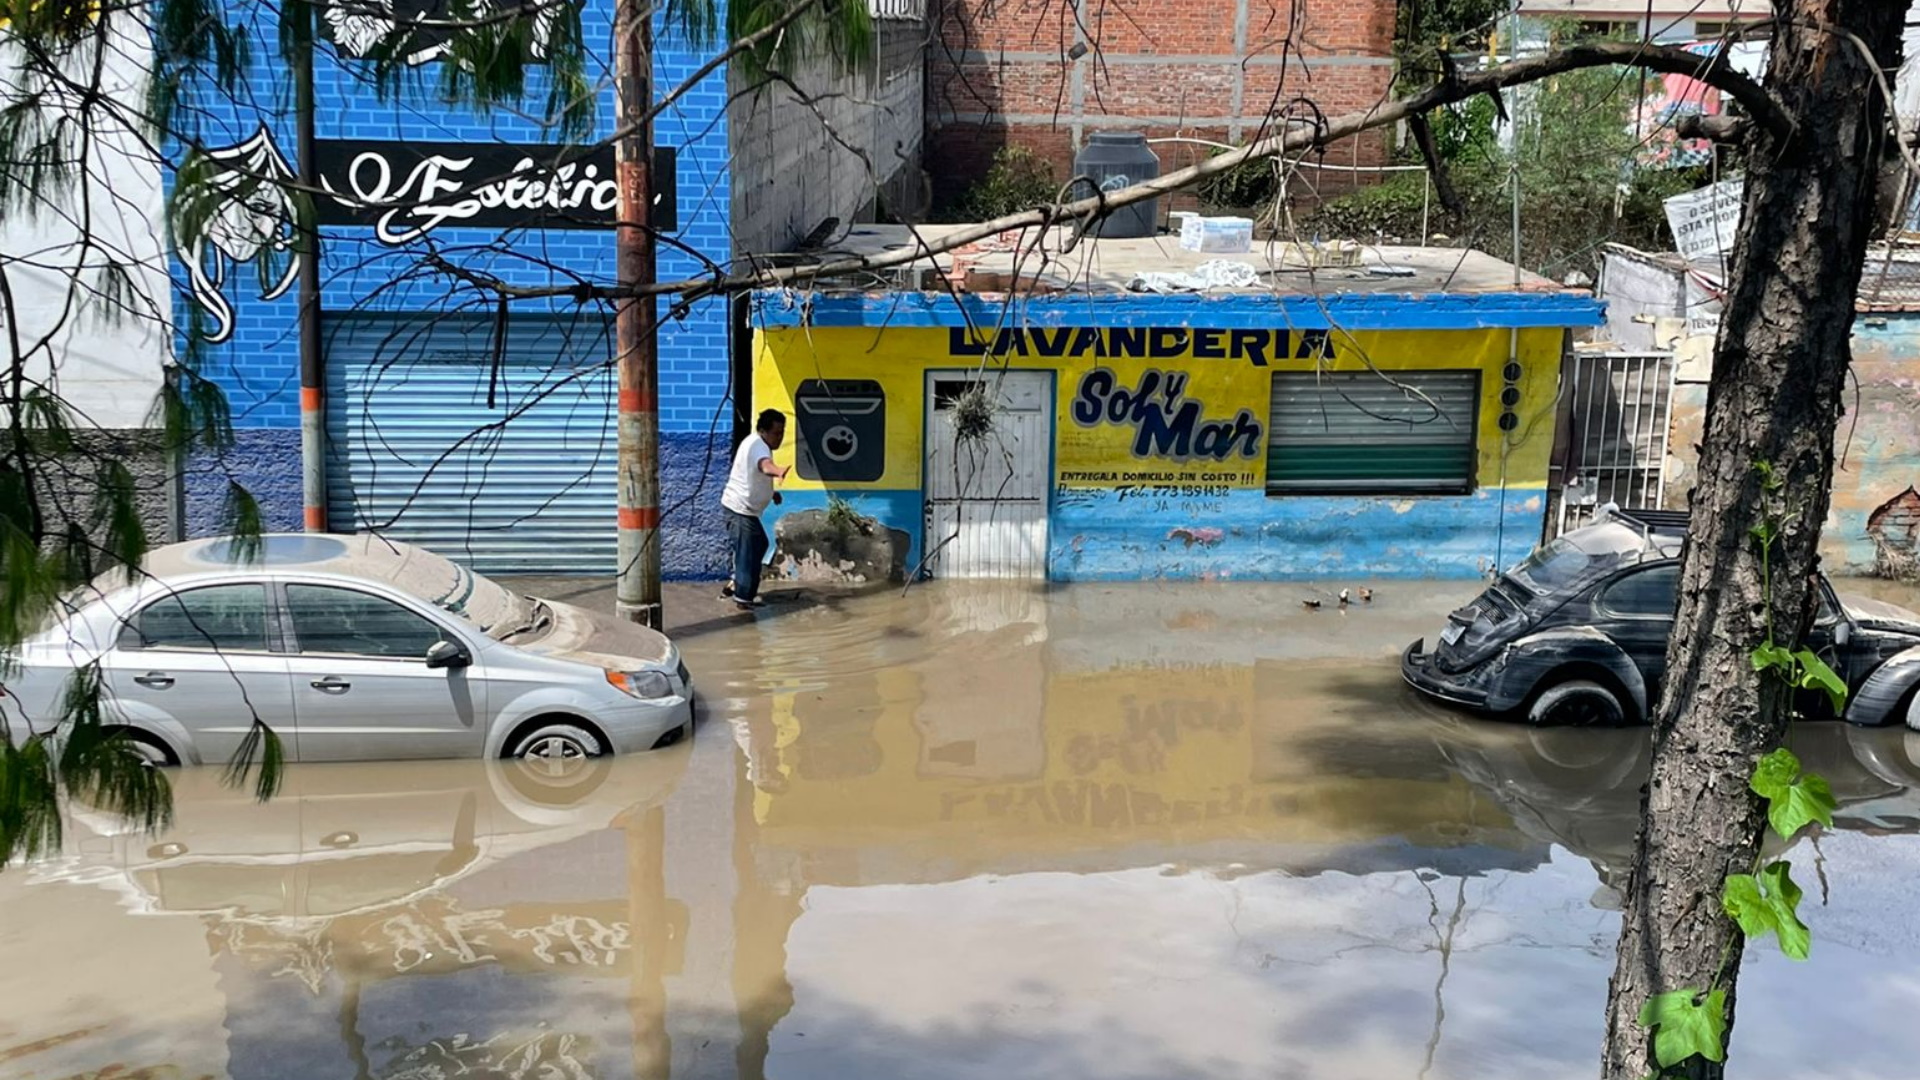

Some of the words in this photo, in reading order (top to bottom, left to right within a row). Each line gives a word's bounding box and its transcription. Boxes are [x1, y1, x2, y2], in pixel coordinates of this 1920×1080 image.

[320, 152, 661, 243] Estétic
[949, 327, 1336, 366] LAVANDERIA
[1075, 370, 1161, 424] Sol
[1135, 402, 1260, 457] Mar
[1122, 472, 1174, 481] DOMICILIO
[1177, 472, 1196, 482] SIN
[1201, 472, 1237, 482] COSTO
[1152, 485, 1178, 498] 773
